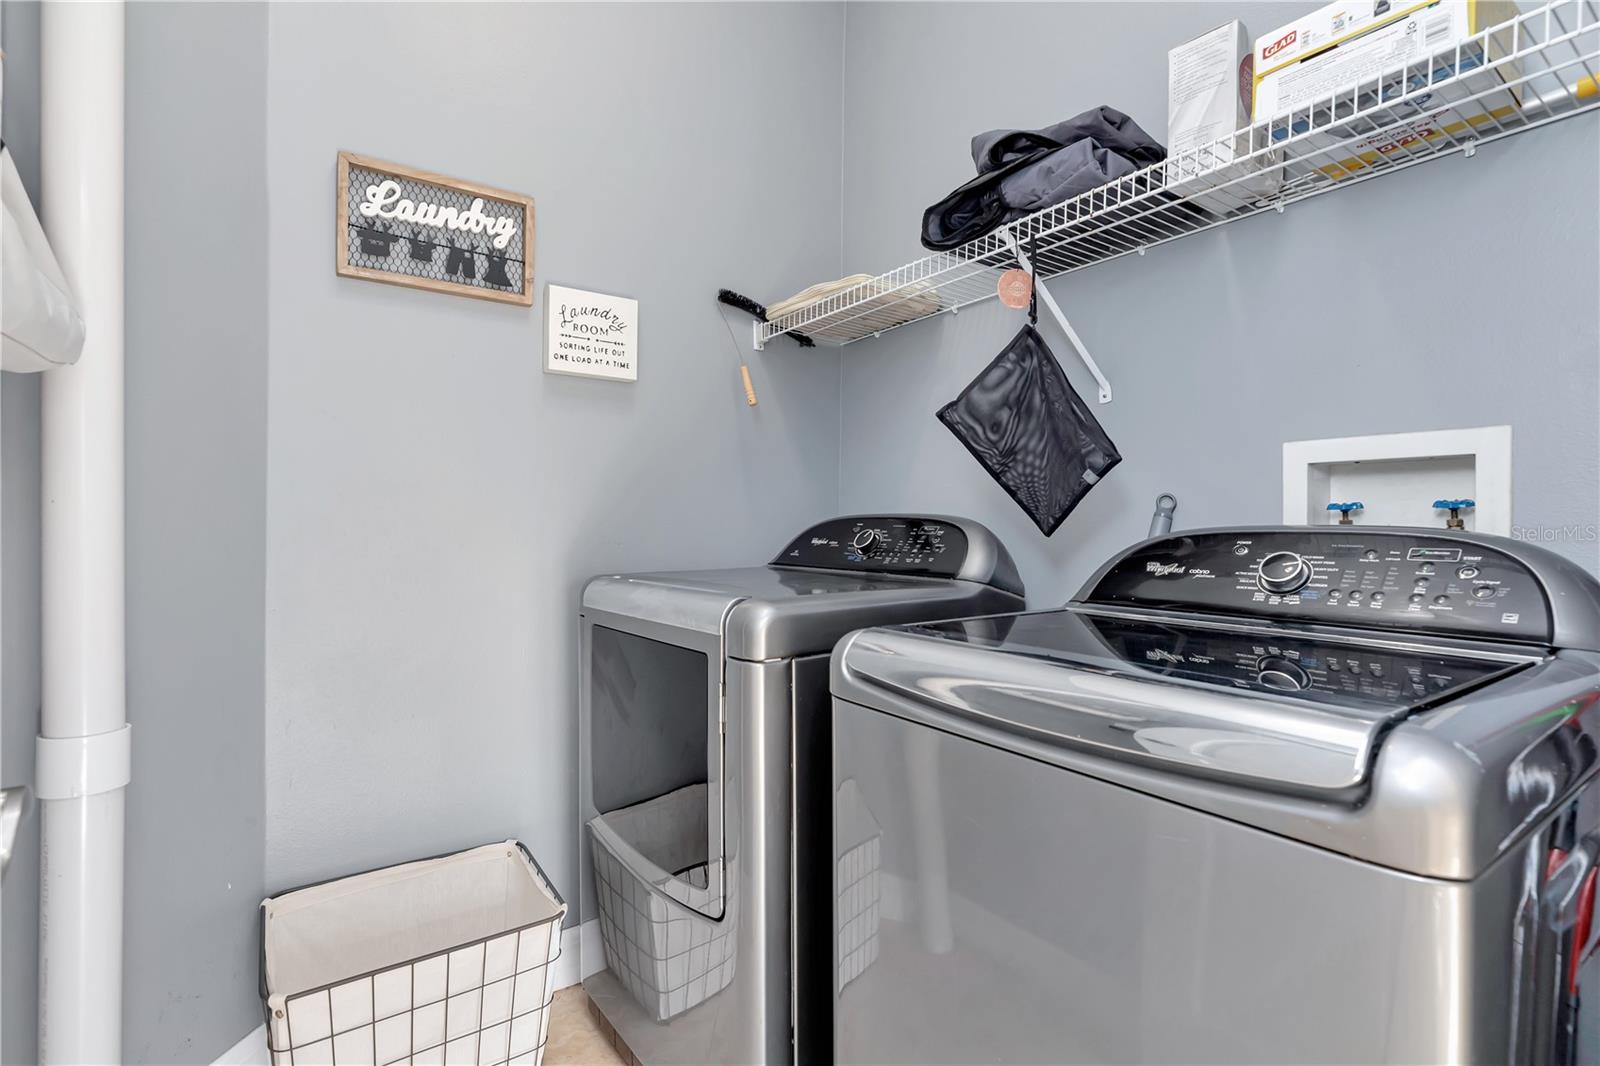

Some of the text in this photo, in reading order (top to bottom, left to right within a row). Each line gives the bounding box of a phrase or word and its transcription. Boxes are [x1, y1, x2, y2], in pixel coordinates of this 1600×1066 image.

[1263, 32, 1297, 58] GLAD
[359, 180, 517, 249] Laundry
[558, 304, 628, 334] Laundry
[573, 323, 609, 336] ROOM
[559, 342, 625, 357] SORTING LIFE OUT
[553, 353, 569, 361] ONE
[571, 356, 592, 364] LOAD
[613, 361, 630, 369] TIME
